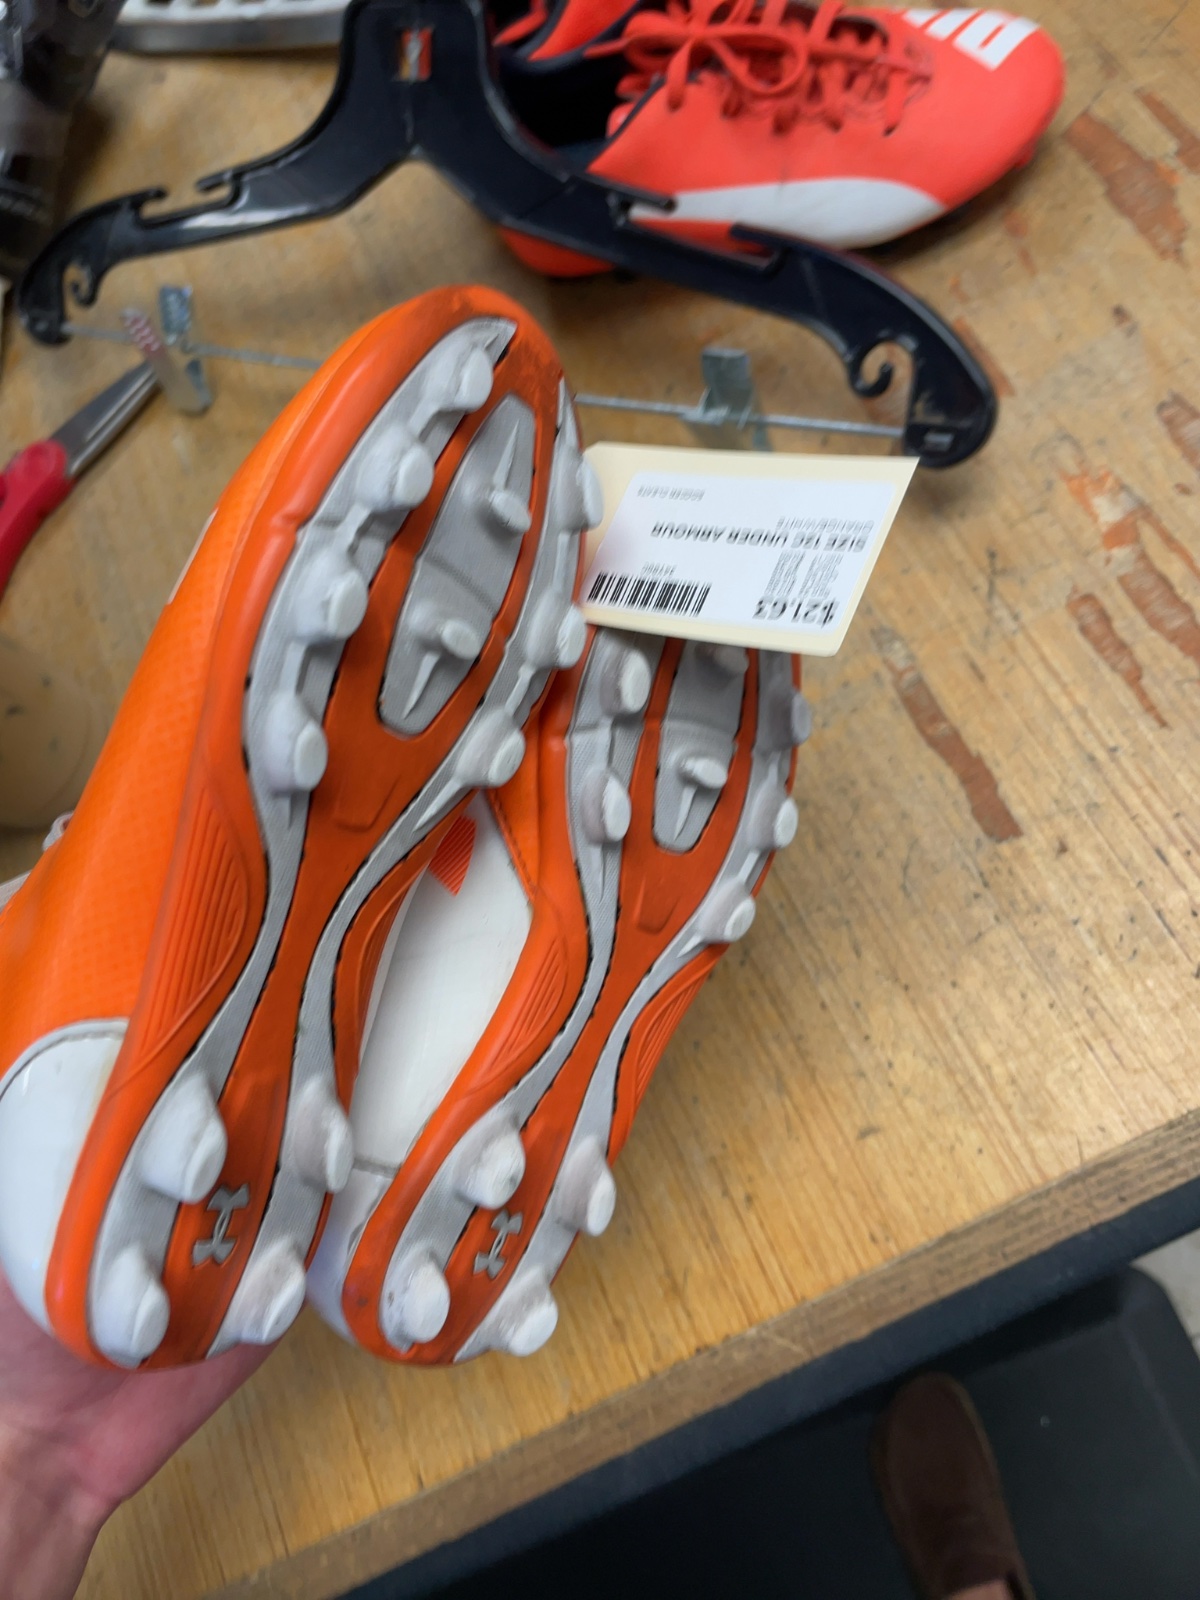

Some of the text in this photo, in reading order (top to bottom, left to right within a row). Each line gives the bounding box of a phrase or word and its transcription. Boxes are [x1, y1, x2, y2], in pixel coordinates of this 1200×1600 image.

[650, 520, 727, 543] ARMOUR
[776, 516, 875, 534] ORANGE/WHITE
[726, 526, 789, 548] UNDER
[824, 533, 869, 552] SIZE
[753, 598, 836, 628] $21.63
